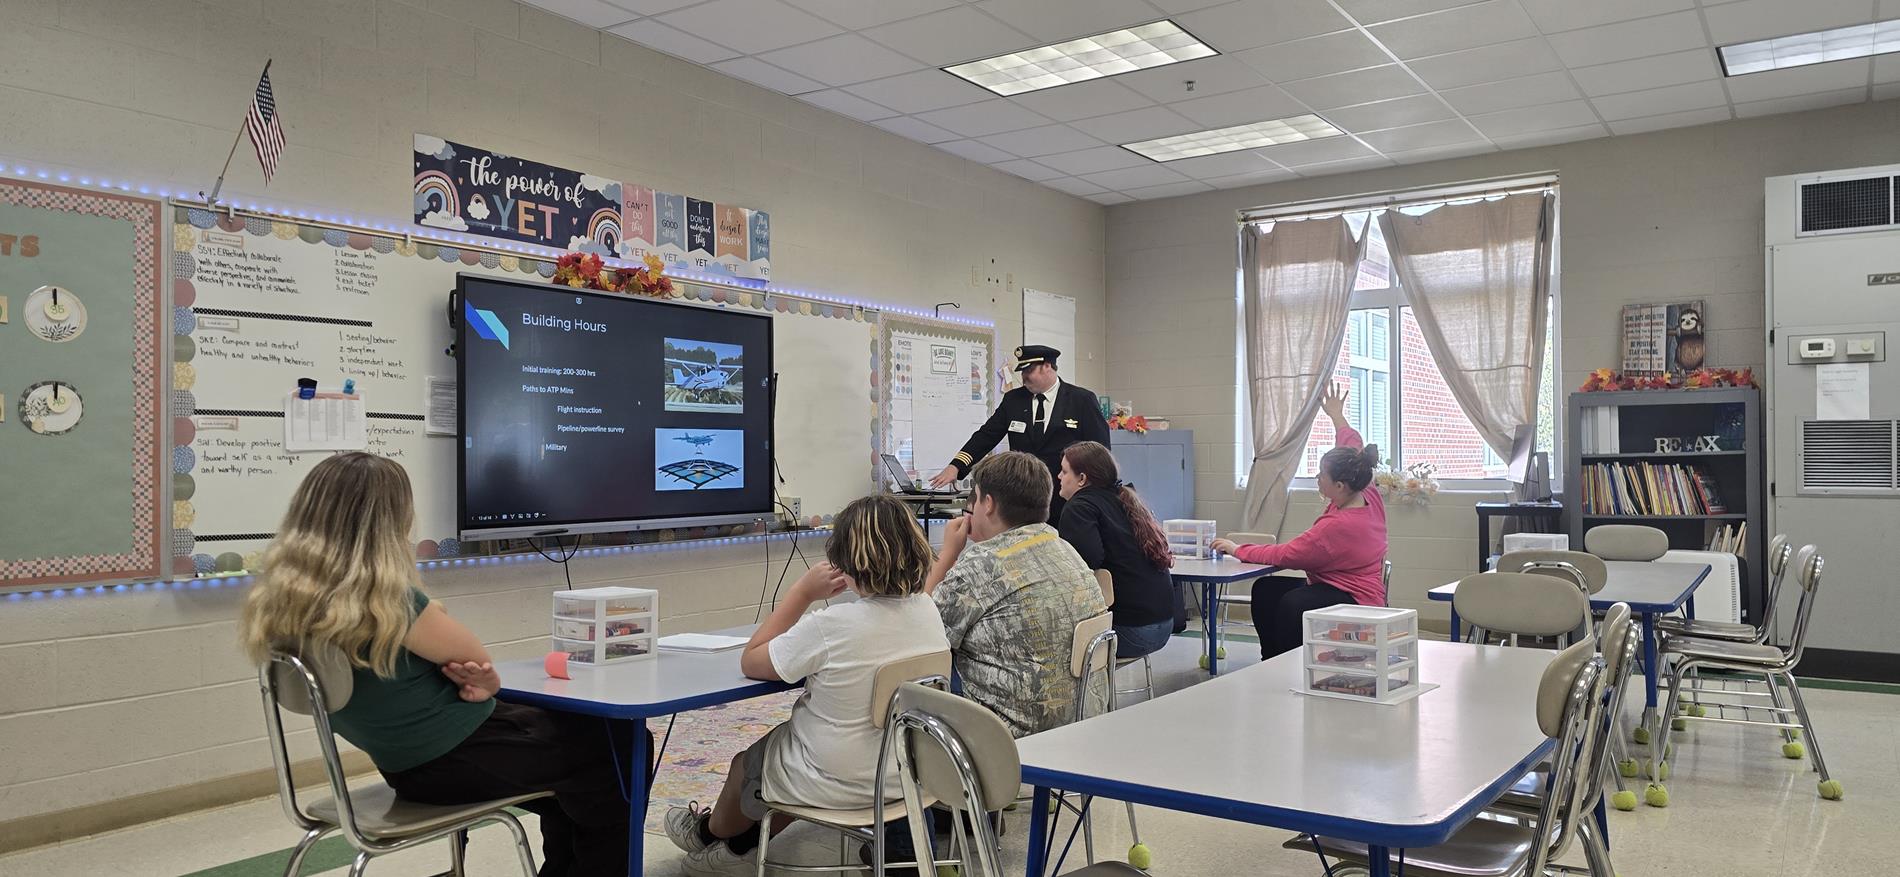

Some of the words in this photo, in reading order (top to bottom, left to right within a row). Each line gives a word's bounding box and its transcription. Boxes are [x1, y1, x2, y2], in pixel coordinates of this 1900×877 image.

[460, 156, 501, 187] the
[505, 175, 562, 202] power
[564, 182, 586, 209] of
[625, 200, 649, 213] CAN'T
[697, 202, 701, 214] I
[492, 194, 560, 240] YET
[632, 211, 643, 221] DO
[690, 214, 710, 226] DON'T
[631, 221, 643, 235] this
[661, 219, 679, 230] GOOD
[719, 221, 743, 235] doesn't
[694, 234, 706, 248] this
[719, 235, 744, 246] WORK
[630, 246, 645, 257] YET
[663, 252, 678, 263] YET
[695, 257, 709, 268] YET
[264, 266, 278, 275] with
[724, 263, 739, 273] YET
[266, 284, 272, 292] of
[522, 312, 572, 332] Building
[574, 318, 607, 333] Hours
[271, 340, 300, 350] contrast
[200, 347, 228, 359] healthy
[284, 355, 315, 367] behaviors
[387, 359, 404, 368] work
[522, 365, 538, 373] Initial
[539, 366, 562, 376] training:
[562, 367, 587, 376] 200-300
[587, 369, 596, 377] hrs
[522, 384, 539, 393] Paths
[539, 385, 546, 393] to
[546, 386, 559, 394] ATP
[560, 386, 574, 394] Mins
[557, 405, 573, 414] Flight
[573, 406, 602, 414] instruction
[557, 424, 607, 433] Pipeline/powerline
[607, 426, 625, 434] survey
[215, 438, 246, 449] Develop
[251, 438, 281, 450] positive
[545, 443, 568, 452] Military
[200, 450, 227, 462] toward
[232, 452, 249, 461] self
[277, 455, 300, 466] unique
[385, 448, 405, 458] work
[200, 465, 215, 474] and
[218, 464, 242, 477] worthy
